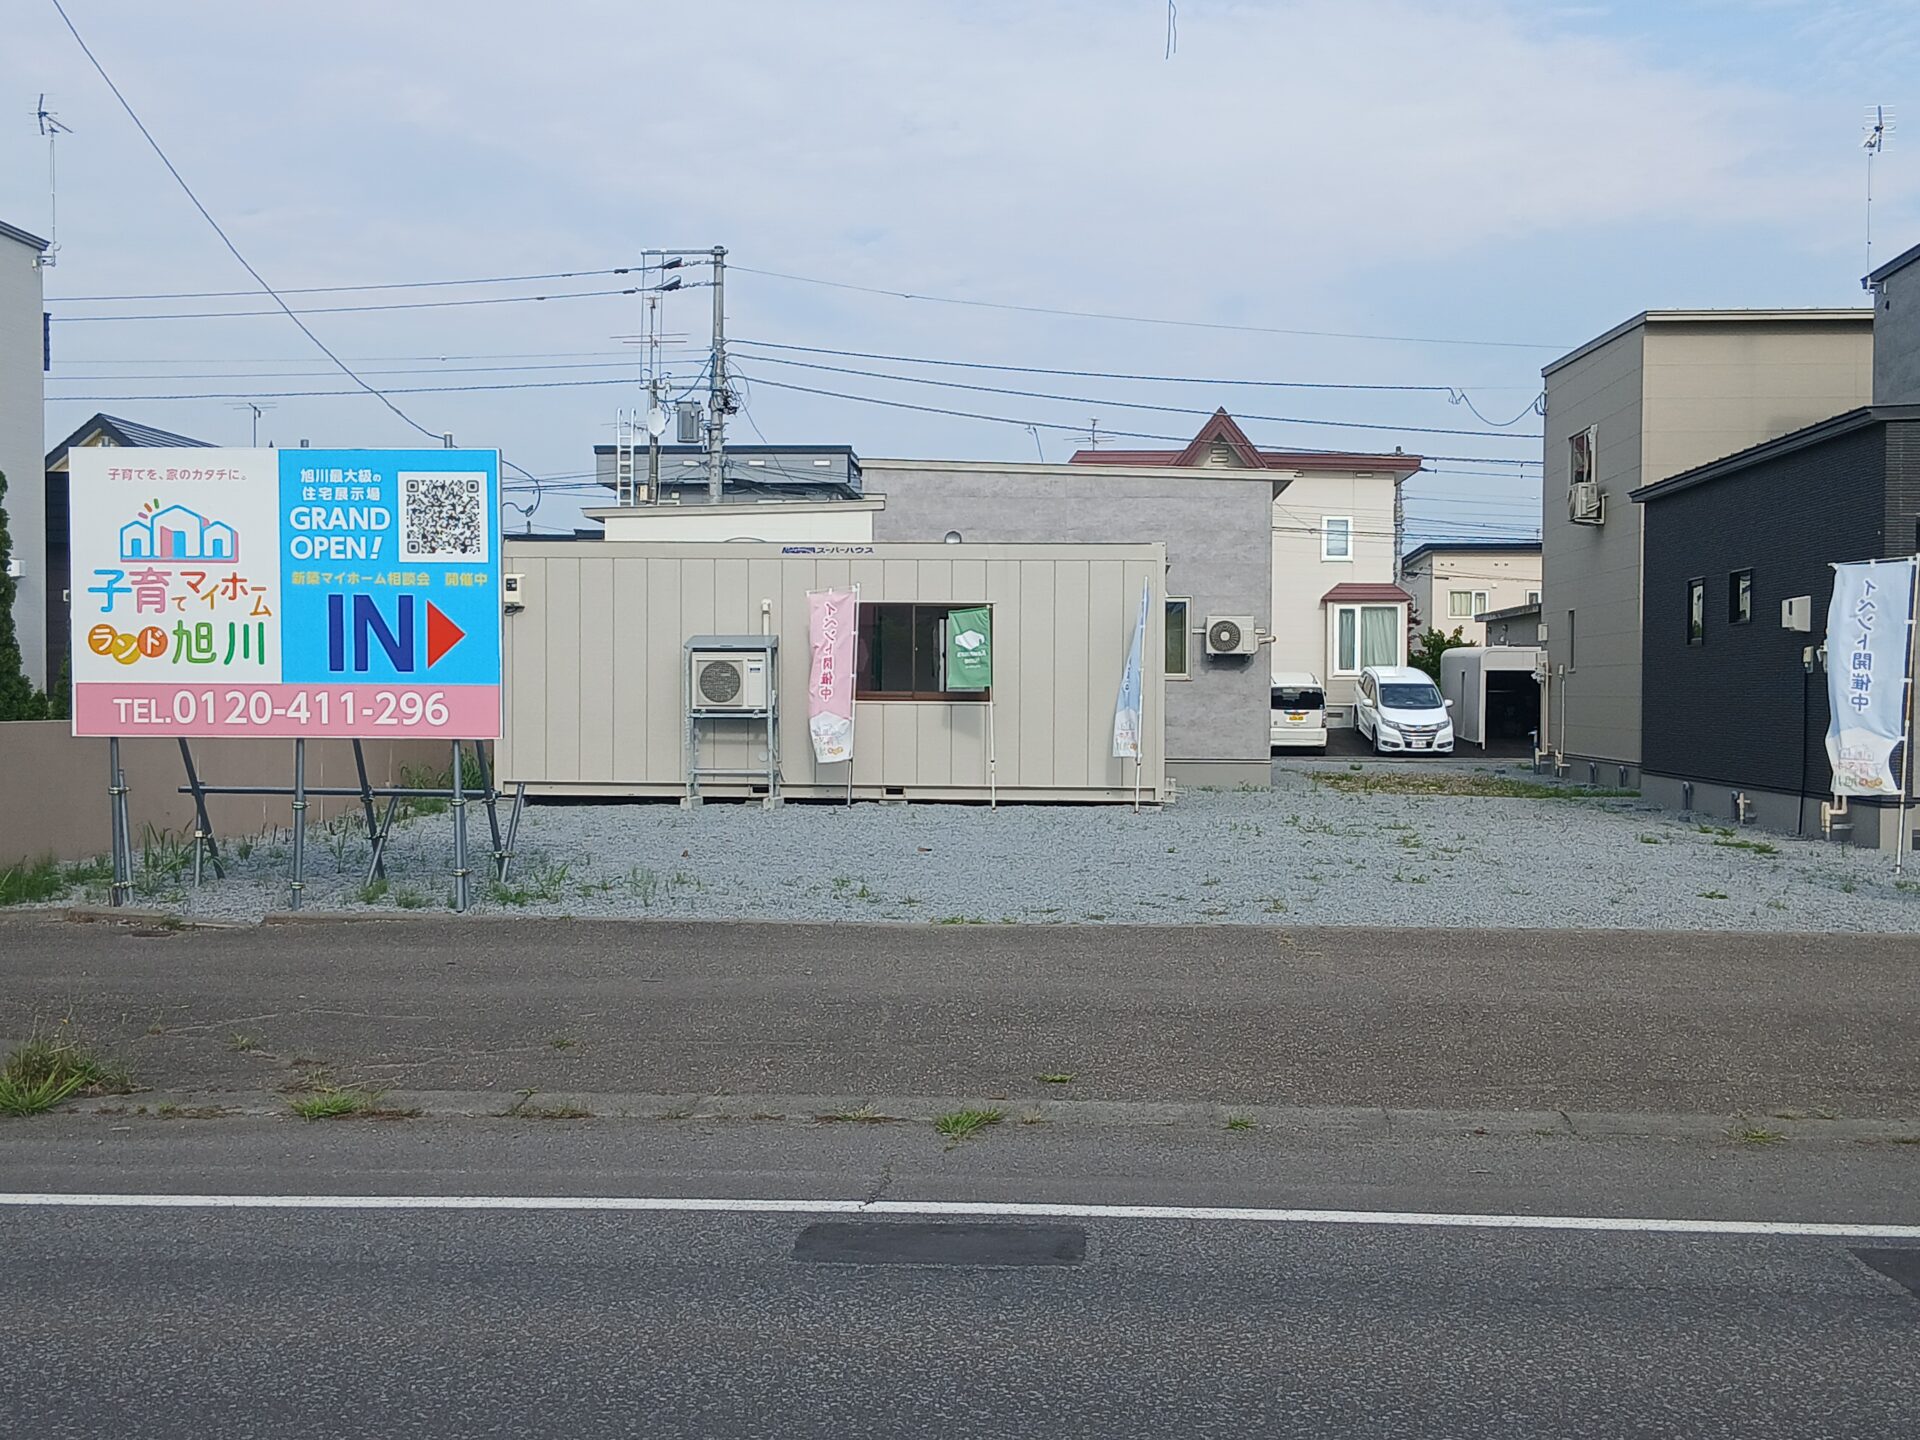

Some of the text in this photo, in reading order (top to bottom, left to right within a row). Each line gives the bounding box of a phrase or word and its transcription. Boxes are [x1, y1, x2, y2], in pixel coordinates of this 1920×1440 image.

[107, 468, 248, 481] 子育てを、家のカタチに。
[300, 469, 382, 483] 旭川最大級の
[302, 487, 381, 501] 住宅展示場
[289, 507, 391, 531] GRAND
[290, 536, 383, 560] OPEN!
[87, 566, 273, 616] 子育てマイホーム
[87, 619, 266, 666] ランド旭川
[328, 594, 414, 673] IN
